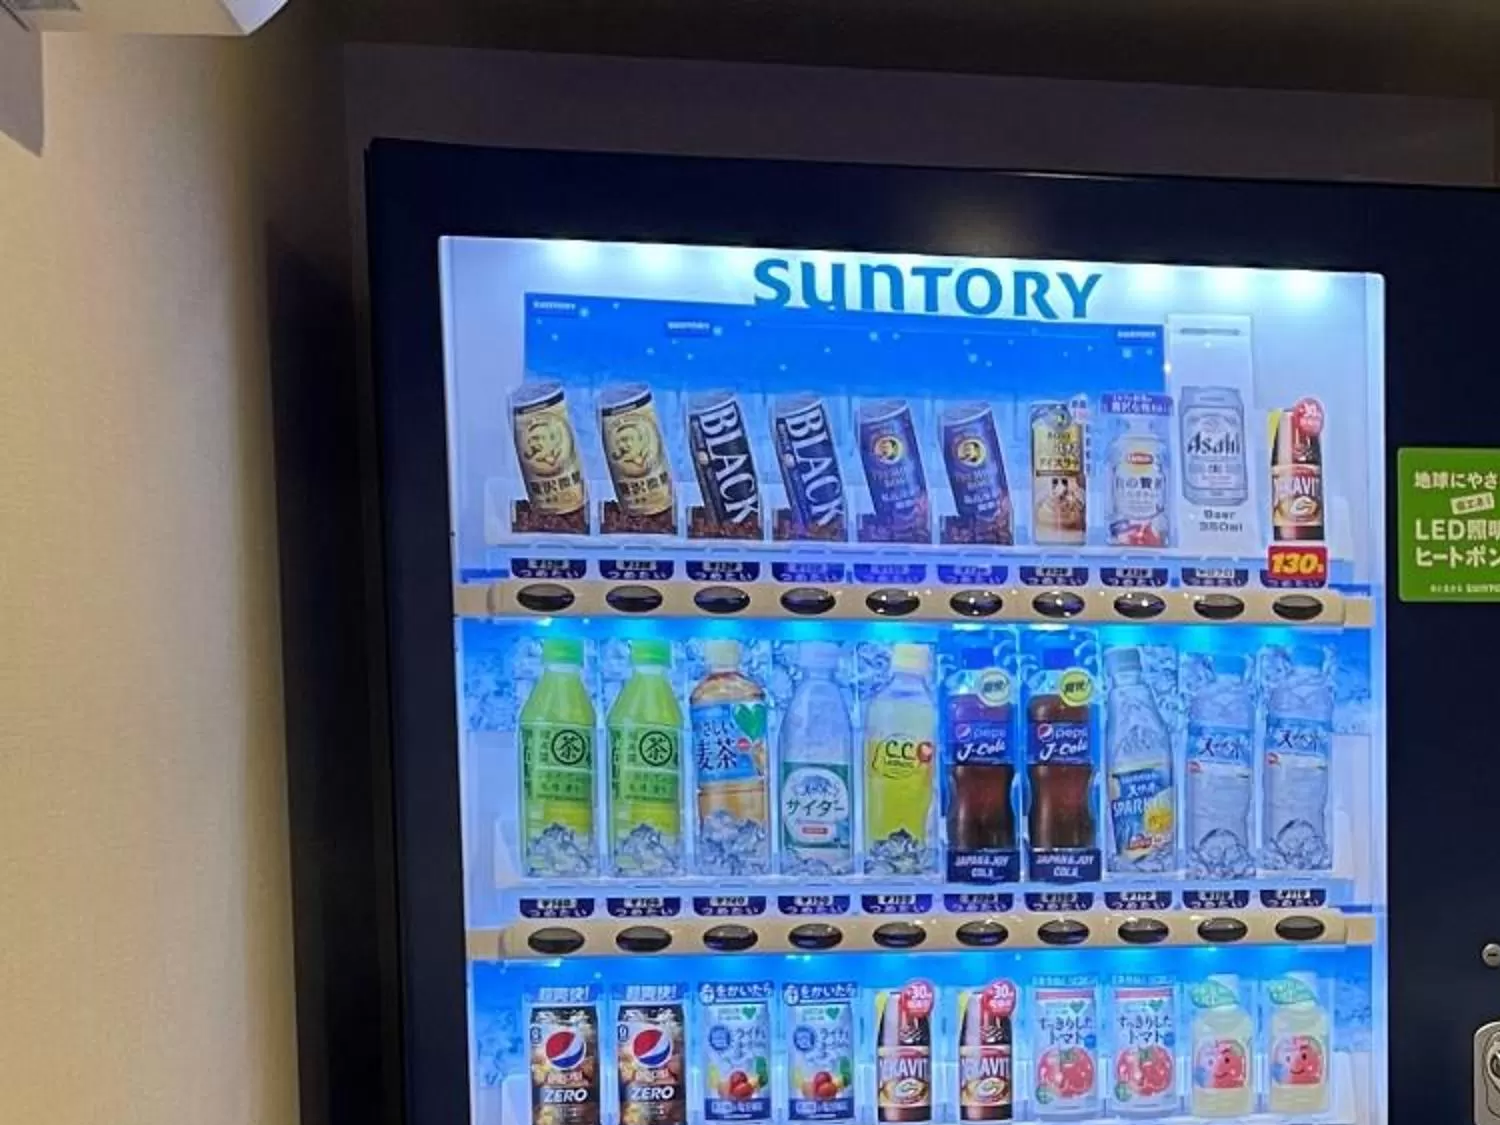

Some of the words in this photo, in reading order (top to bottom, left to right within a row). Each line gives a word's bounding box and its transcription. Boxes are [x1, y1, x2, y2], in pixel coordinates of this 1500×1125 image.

[753, 258, 1101, 320] SUNTORY
[1186, 430, 1241, 456] Asahi
[699, 400, 761, 525] BLACK
[785, 403, 845, 527] BLACK
[1204, 508, 1237, 520] Beer
[554, 732, 583, 762] 茶
[642, 734, 670, 763] 茶
[786, 799, 846, 817] サイダー
[543, 1088, 589, 1104] ZERO
[629, 1086, 676, 1102] ZERO
